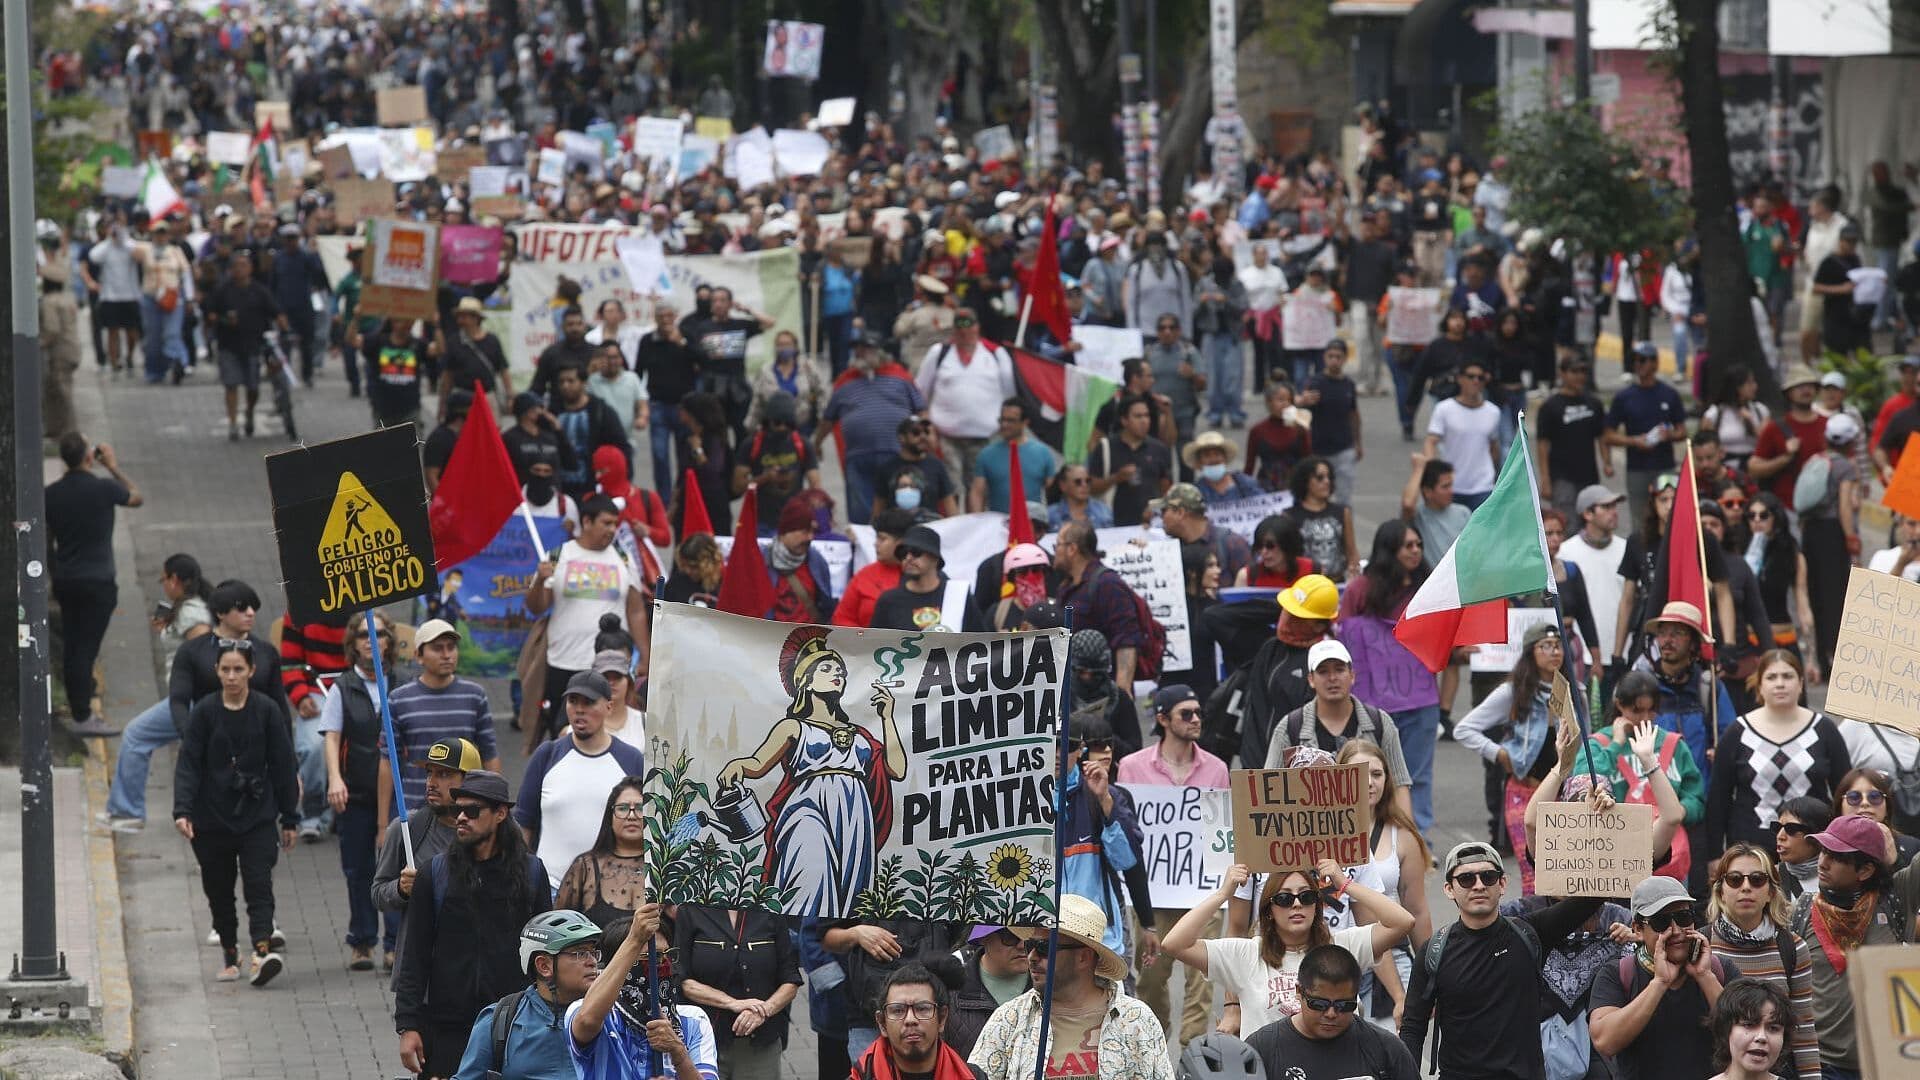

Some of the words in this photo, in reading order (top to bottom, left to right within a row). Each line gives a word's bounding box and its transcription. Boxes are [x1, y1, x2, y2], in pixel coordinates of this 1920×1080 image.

[322, 527, 395, 561] PELIGRO
[323, 550, 391, 578] GOBIERNO
[394, 544, 410, 557] DE
[319, 556, 424, 612] JALISCO
[1845, 612, 1884, 637] POR
[1892, 624, 1915, 646] MI
[914, 635, 1058, 699] AGUA
[1839, 642, 1882, 669] CON
[911, 688, 1056, 754] LIMPIA
[927, 754, 994, 788] PARA
[1000, 746, 1045, 776] LAS
[1300, 767, 1360, 807] SILENCIO
[902, 774, 1055, 846] PLANTAS
[1545, 813, 1626, 831] NOSOTROS
[1544, 834, 1562, 850] SÍ
[1566, 837, 1614, 852] SOMOS
[1545, 857, 1594, 871] DIGNOS
[1598, 858, 1617, 870] DE
[1622, 859, 1646, 872] ESTA
